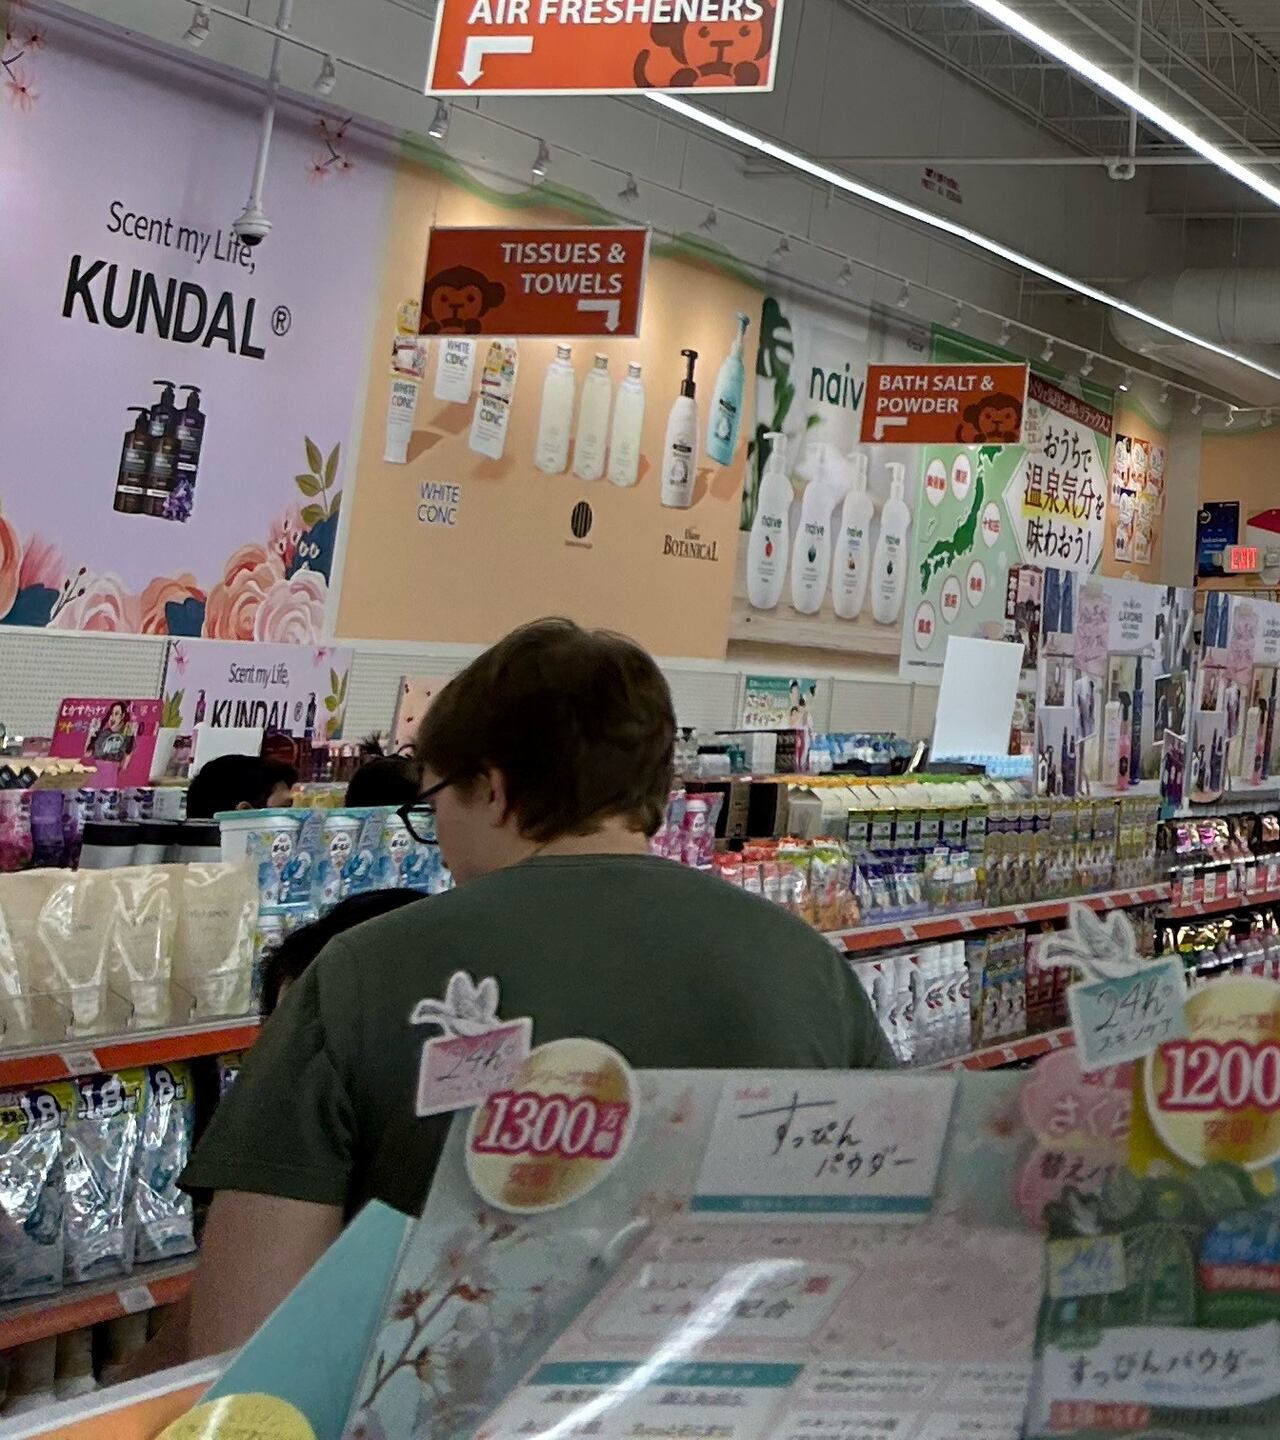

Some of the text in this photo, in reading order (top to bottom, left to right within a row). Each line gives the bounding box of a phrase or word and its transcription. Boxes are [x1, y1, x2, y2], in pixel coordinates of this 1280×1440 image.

[107, 201, 172, 247] Scent
[176, 226, 211, 264] my
[501, 242, 626, 264] TISSUES &
[521, 272, 622, 295] TOWELS
[809, 362, 864, 411] naiv
[879, 375, 994, 392] BATH SALT &
[877, 397, 958, 413] POWDER
[1044, 426, 1092, 472] おうちで
[420, 481, 460, 503] WHITE
[1024, 462, 1105, 521] 温泉気分を
[416, 504, 458, 526] CONC
[228, 663, 256, 684] Scent
[257, 667, 271, 688] my
[815, 1144, 916, 1178] パウダー
